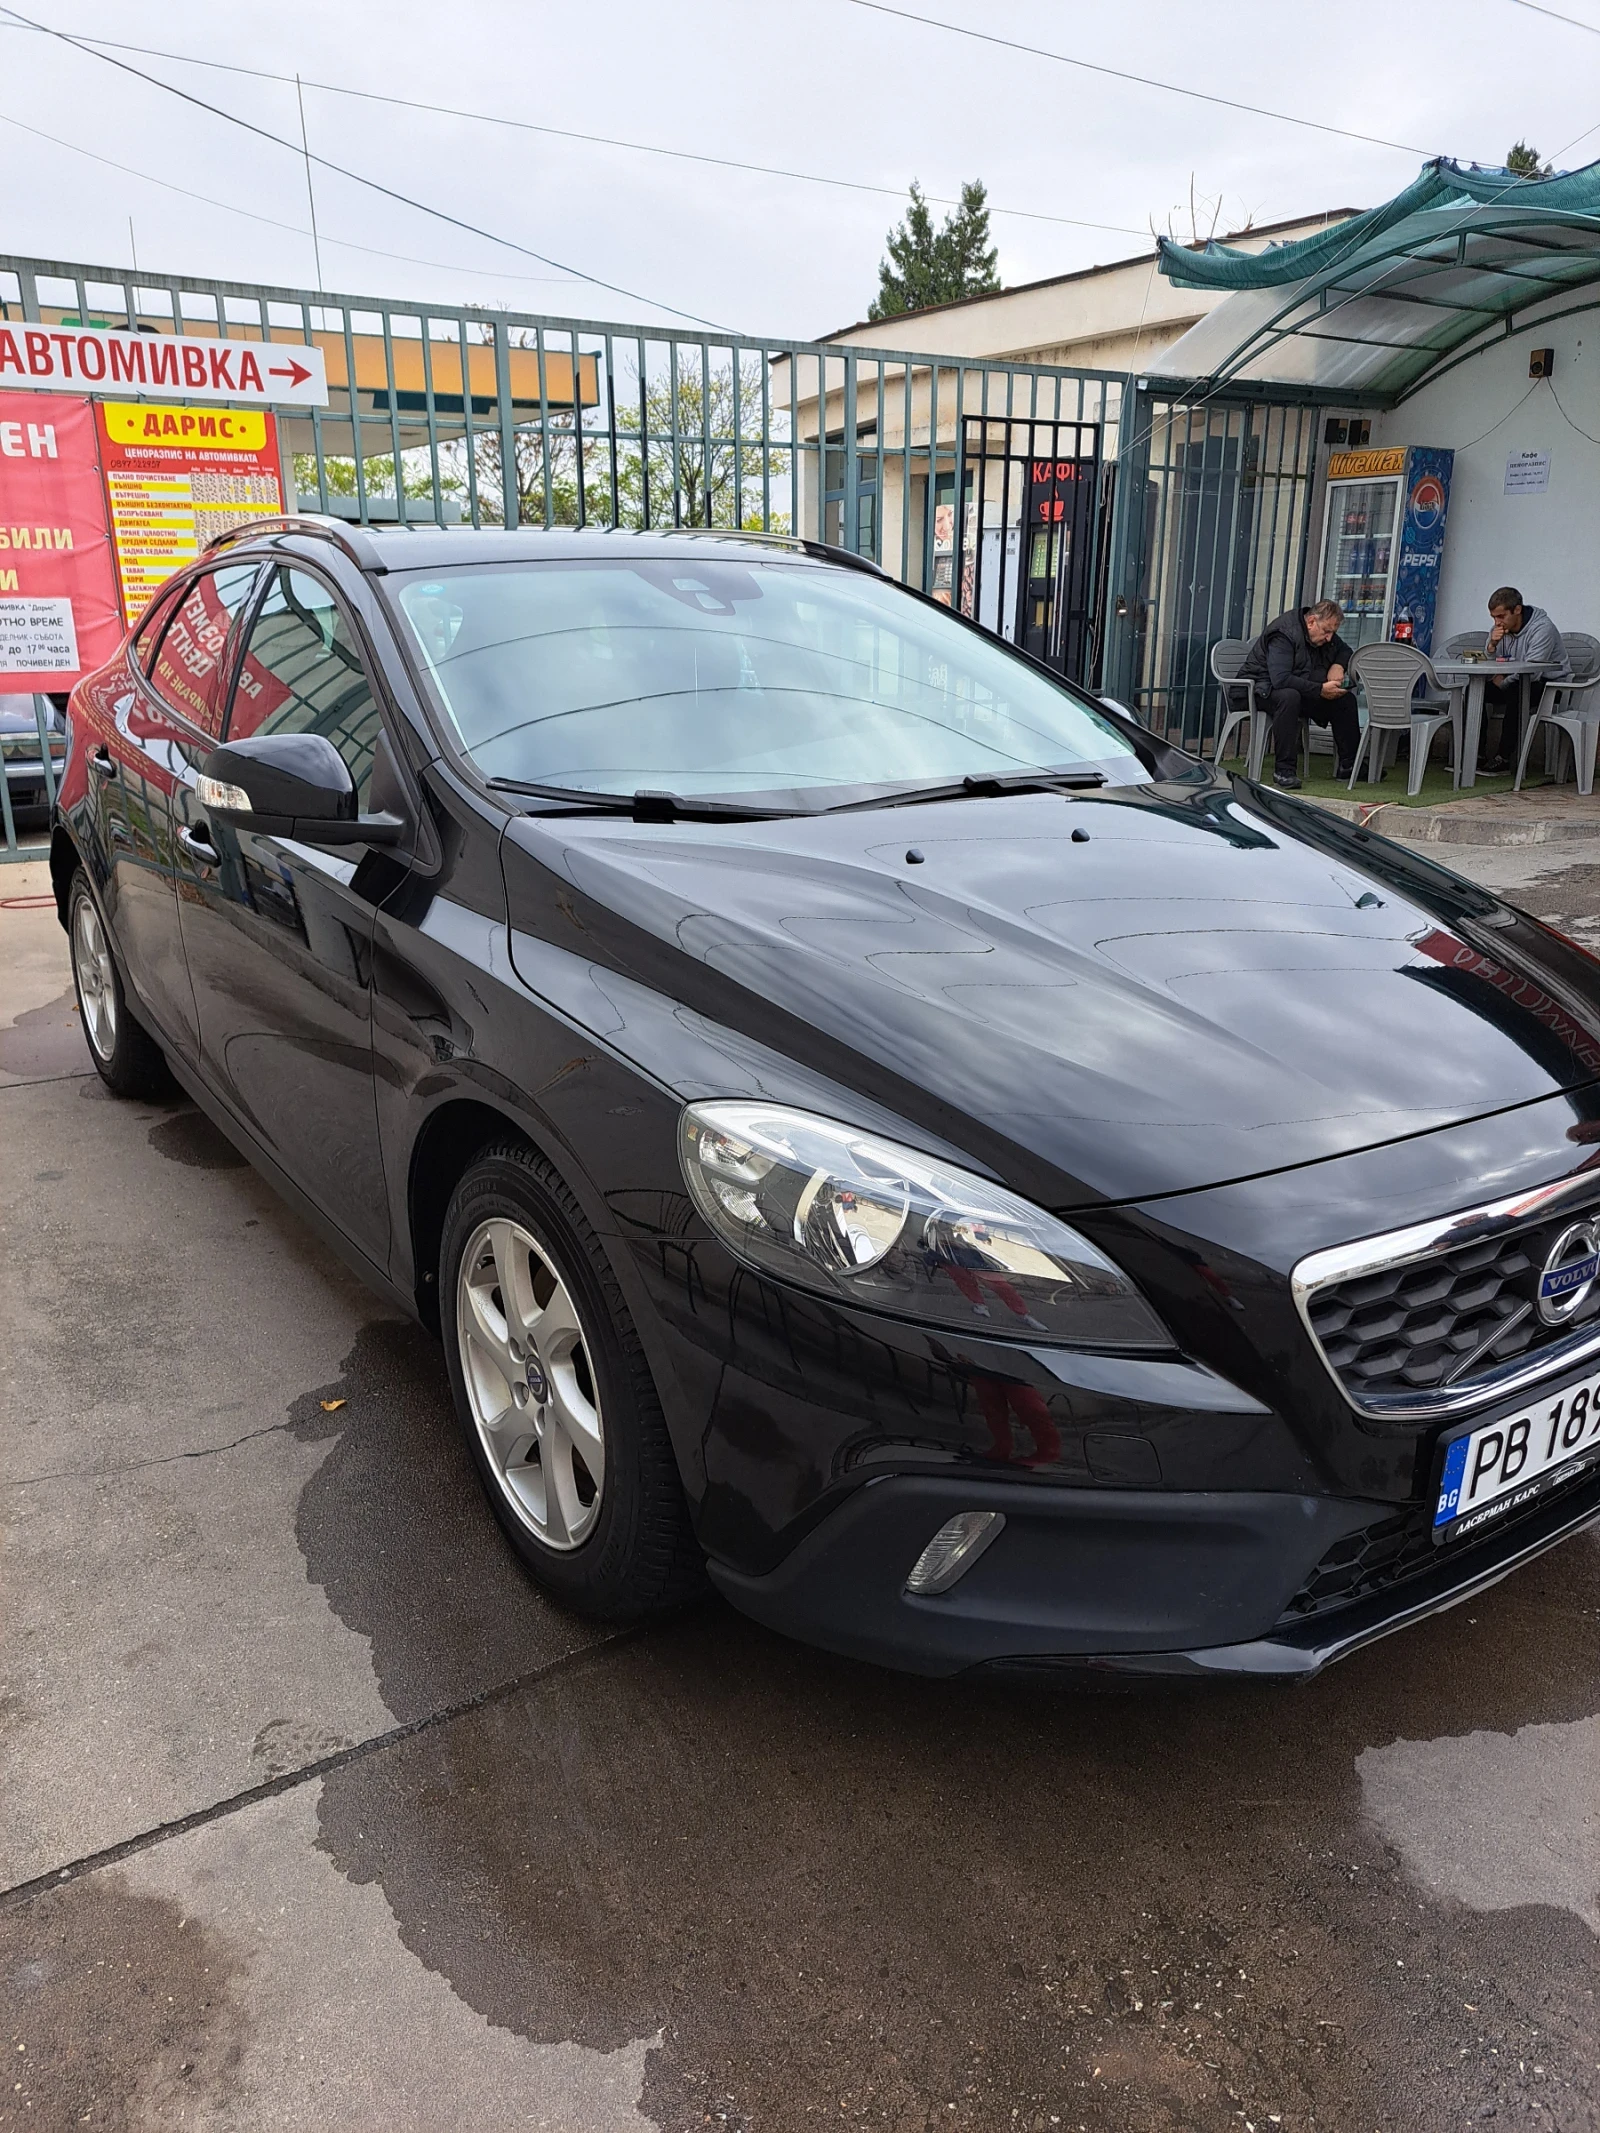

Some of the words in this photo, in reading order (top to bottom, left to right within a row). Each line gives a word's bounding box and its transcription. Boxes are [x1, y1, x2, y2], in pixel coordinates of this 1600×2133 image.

[143, 413, 234, 439] ДАРИС
[125, 448, 182, 460] ЦЕНОРАЗПИС
[185, 450, 197, 460] НА
[199, 451, 258, 463] АВТОМИВКАТА
[1403, 554, 1438, 567] PEPSI
[30, 617, 64, 627] ВРЕМЕ
[34, 633, 64, 641] СЪБОТА
[8, 647, 22, 655] до
[47, 646, 70, 654] часа
[16, 659, 54, 667] ПОЧИВЕН
[55, 659, 71, 667] ДЕН
[1468, 1417, 1531, 1500] PB
[1436, 1488, 1458, 1514] BG
[1455, 1498, 1512, 1536] ЛАСЕРМАН
[1513, 1484, 1540, 1505] КАРС
